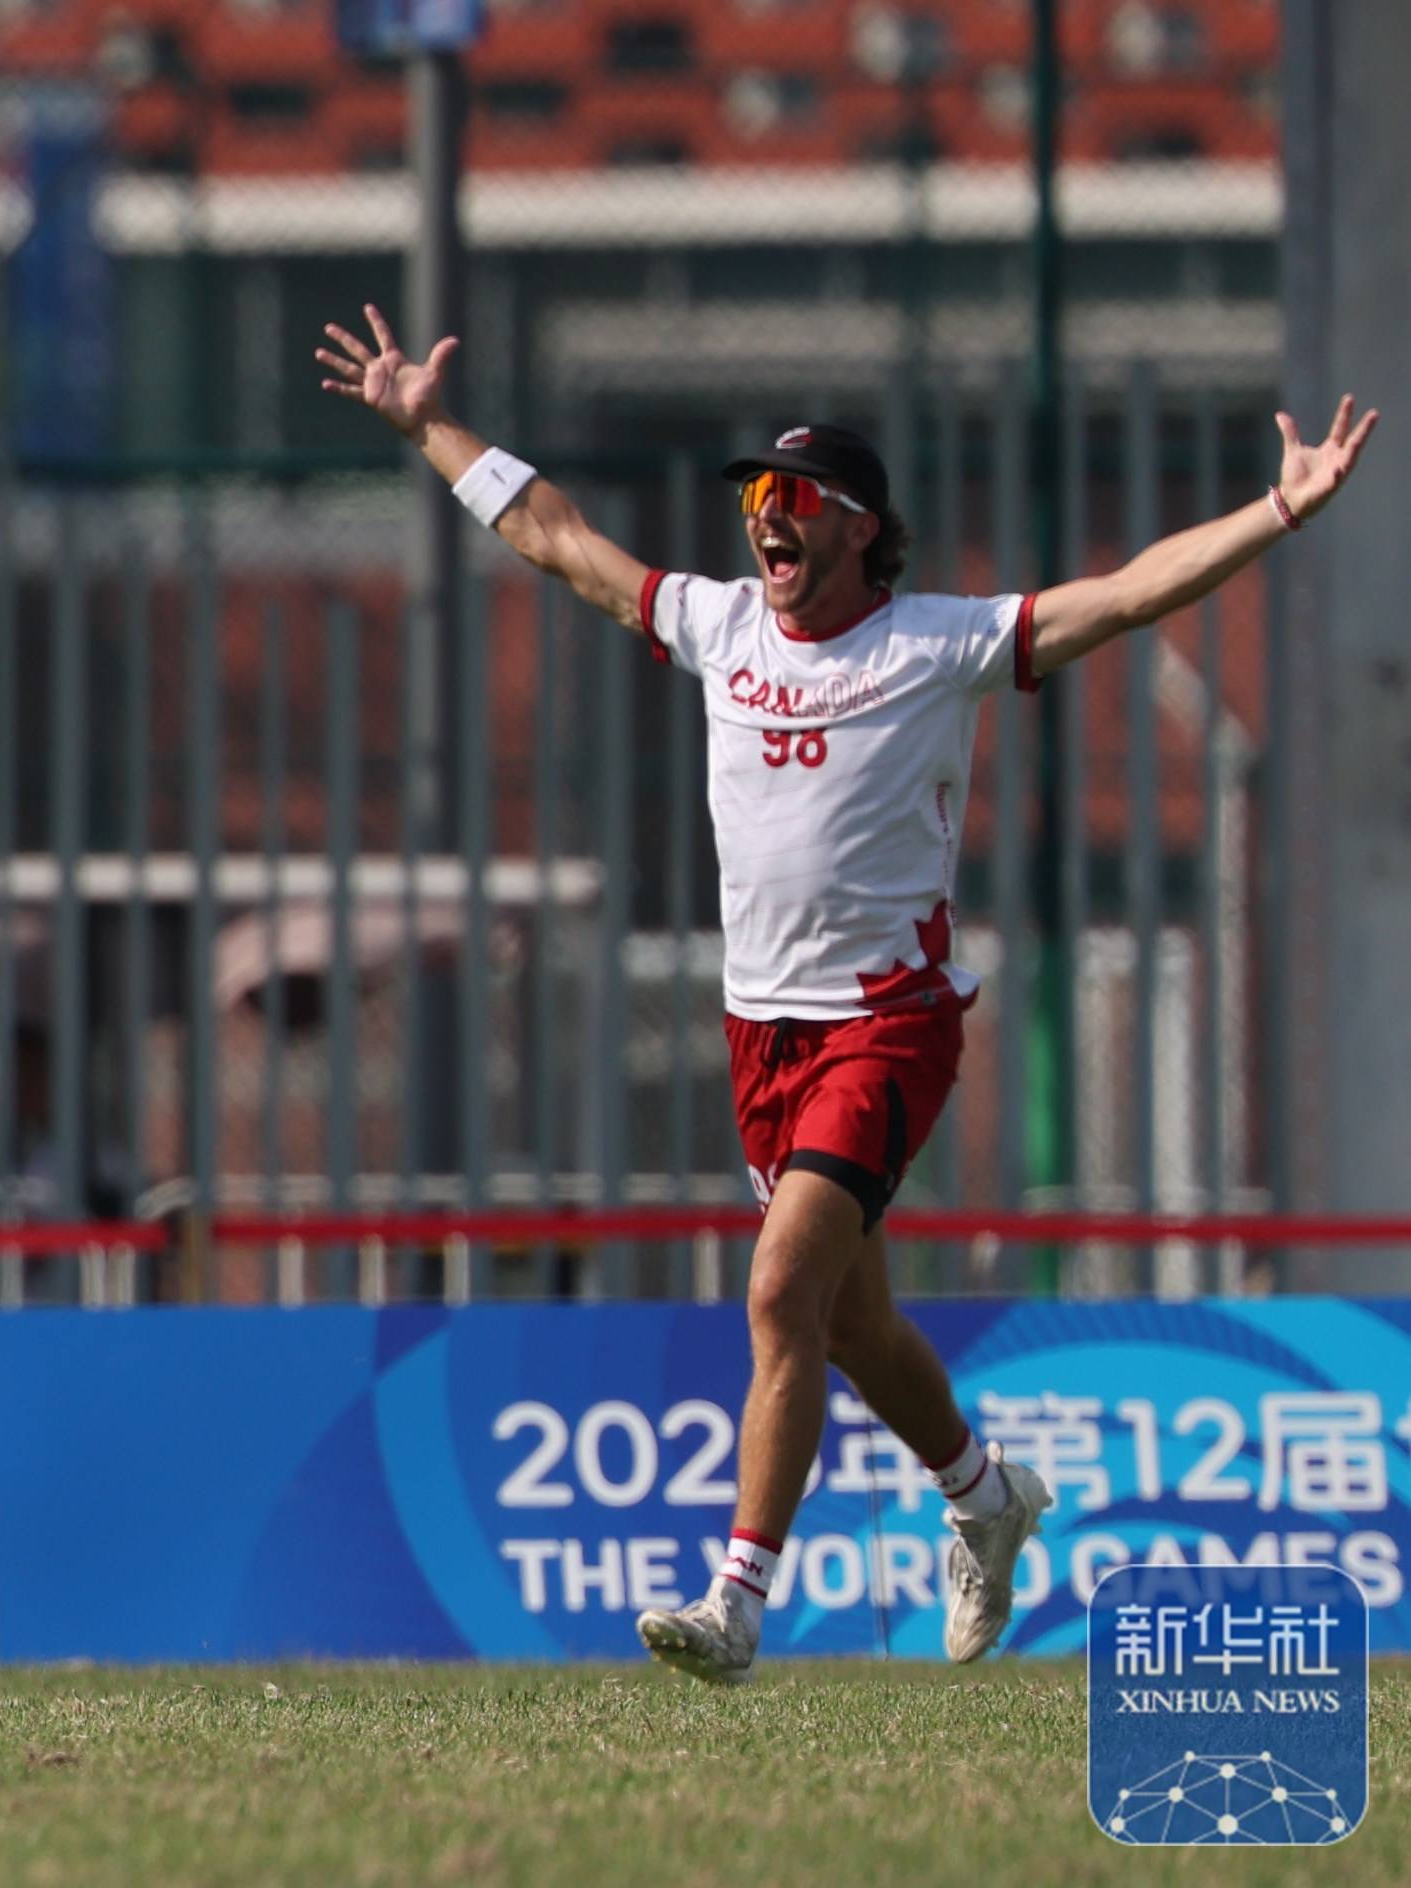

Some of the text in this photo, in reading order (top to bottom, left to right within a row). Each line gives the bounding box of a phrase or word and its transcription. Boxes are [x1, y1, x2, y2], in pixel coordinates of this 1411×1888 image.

[762, 728, 827, 767] 98
[493, 1390, 1411, 1512] 202年第12届
[500, 1536, 685, 1611] THE
[1070, 1530, 1404, 1608] GAMES
